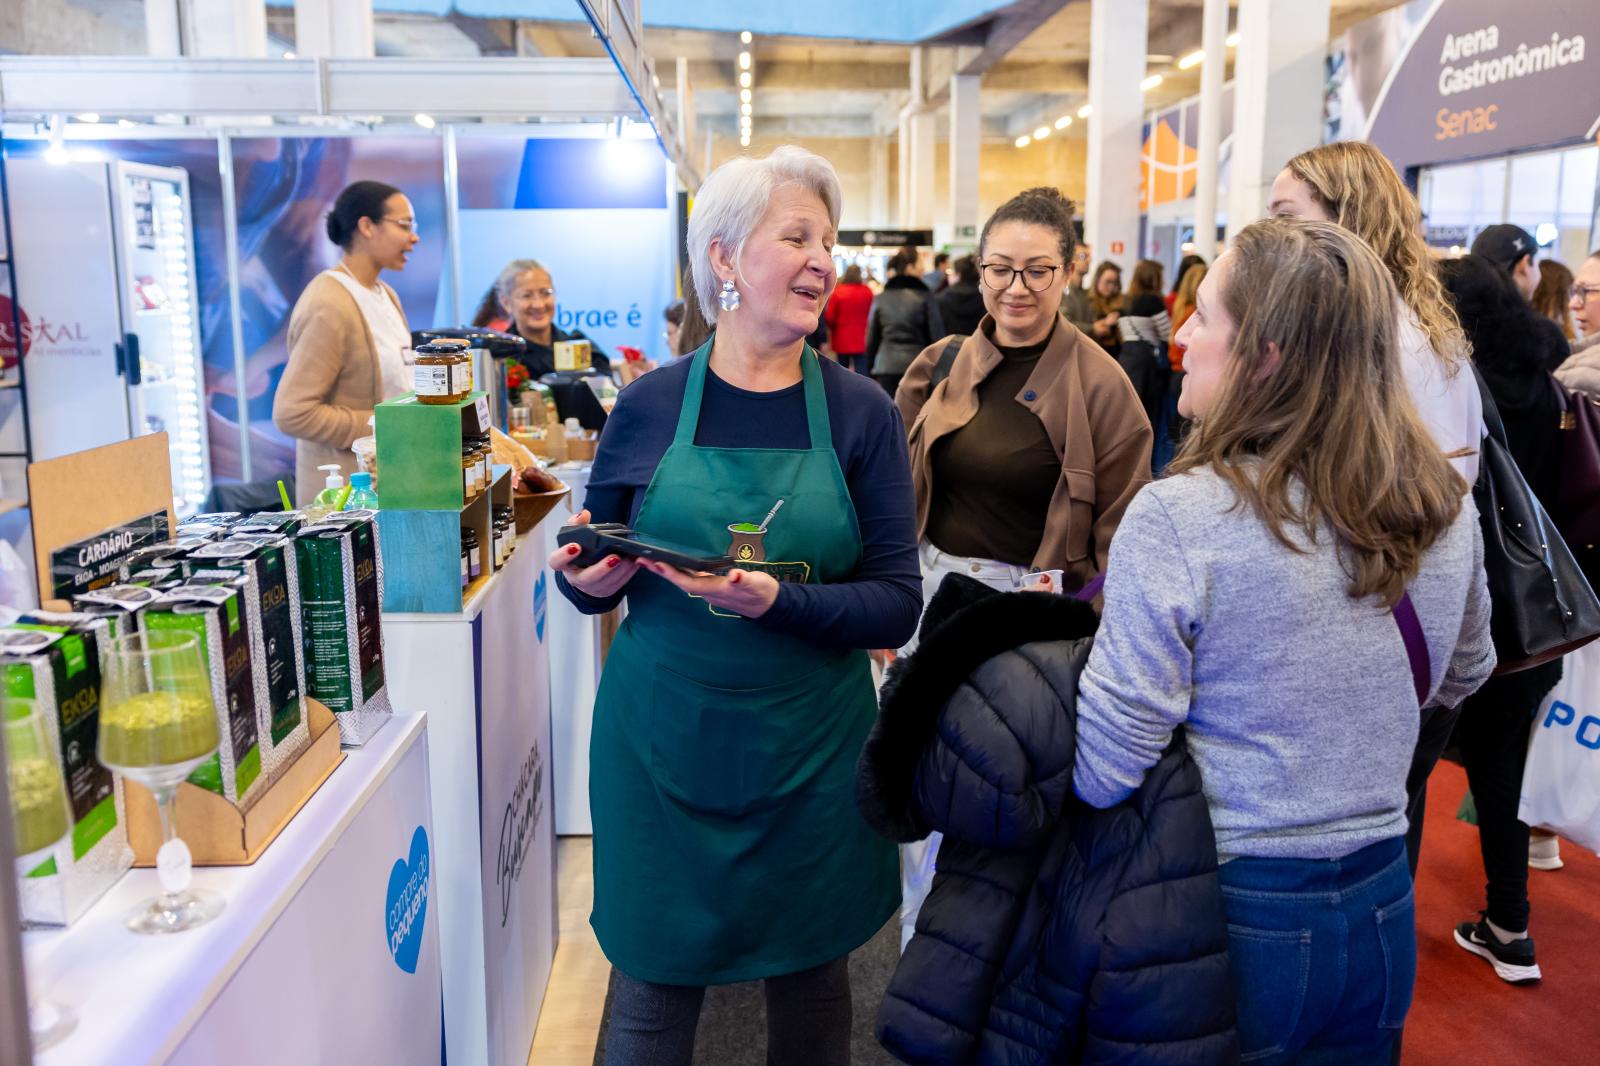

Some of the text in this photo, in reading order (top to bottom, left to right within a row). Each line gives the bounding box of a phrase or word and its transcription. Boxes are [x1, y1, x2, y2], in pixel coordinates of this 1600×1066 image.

[1438, 31, 1586, 96] Gastronômica
[1440, 24, 1499, 64] Arena
[1435, 103, 1499, 141] Senac
[626, 302, 642, 328] é
[79, 531, 132, 567] CARDÁPIO
[389, 852, 428, 930] compre do
[391, 876, 430, 957] pequeno
